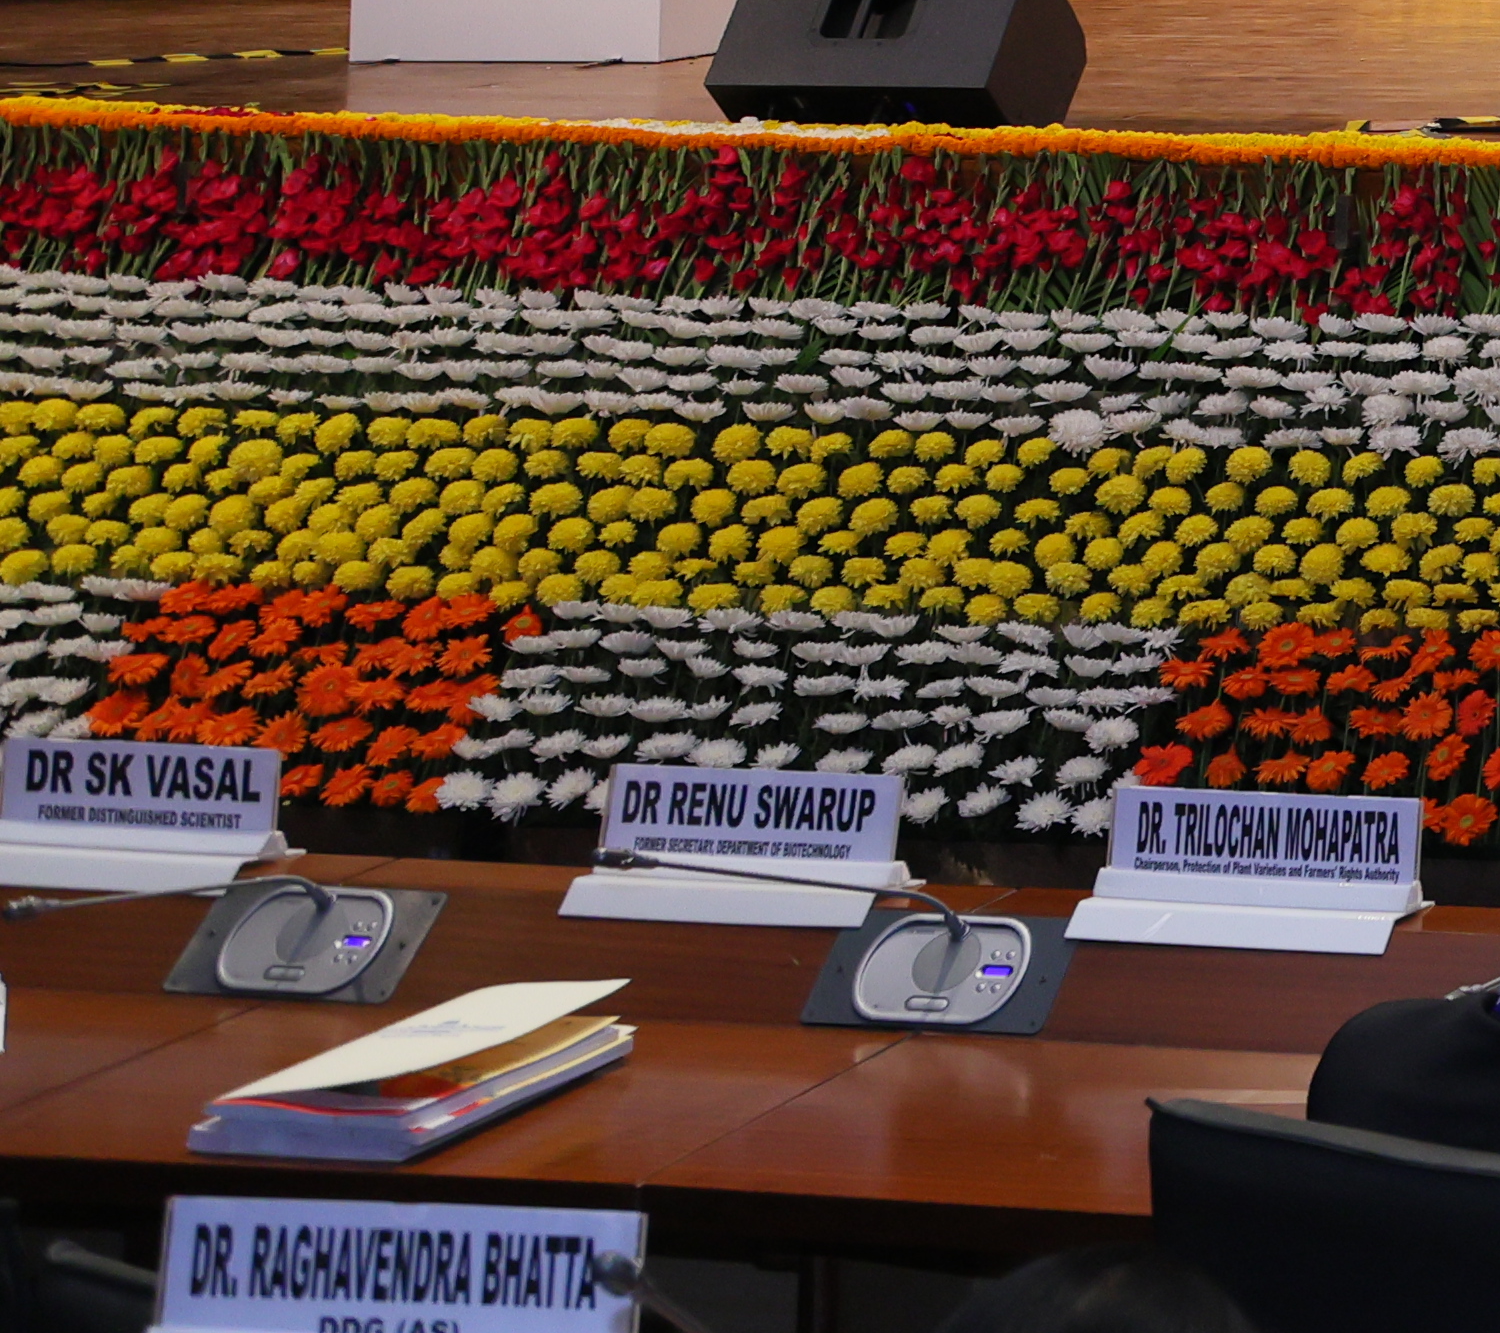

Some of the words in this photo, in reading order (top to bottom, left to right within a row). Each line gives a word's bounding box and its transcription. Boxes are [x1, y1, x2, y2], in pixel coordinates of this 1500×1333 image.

[26, 750, 73, 793] DR
[86, 752, 134, 796] SK
[147, 755, 260, 802] VASAL
[38, 805, 85, 821] FORMER
[89, 808, 177, 825] DISTINGUISHED
[180, 812, 242, 829] SCIENTIST
[622, 781, 661, 824] DR
[668, 782, 748, 827] RENU
[754, 785, 875, 832] SWARUP
[634, 837, 667, 851] FORMER
[668, 838, 714, 855] SECRETARY,
[716, 841, 768, 857] DEPARTMENT
[770, 842, 782, 856] OF
[783, 842, 851, 859] BIOTECHNOLOGY
[1137, 801, 1166, 854] DR.
[1175, 803, 1280, 859] TRILOCHAN
[1285, 808, 1399, 864] MOHAPATRA
[1134, 857, 1180, 874] Chairperson,
[1182, 860, 1221, 874] Protection
[1223, 861, 1231, 874] of
[1233, 862, 1251, 875] Plant
[1254, 863, 1286, 877] Varieties
[1288, 865, 1302, 877] and
[1339, 867, 1362, 881] Rights
[1365, 867, 1400, 884] Authority
[190, 1224, 237, 1297] DR.
[248, 1225, 471, 1304] RAGHAVENDRA
[481, 1233, 596, 1309] BHATTA
